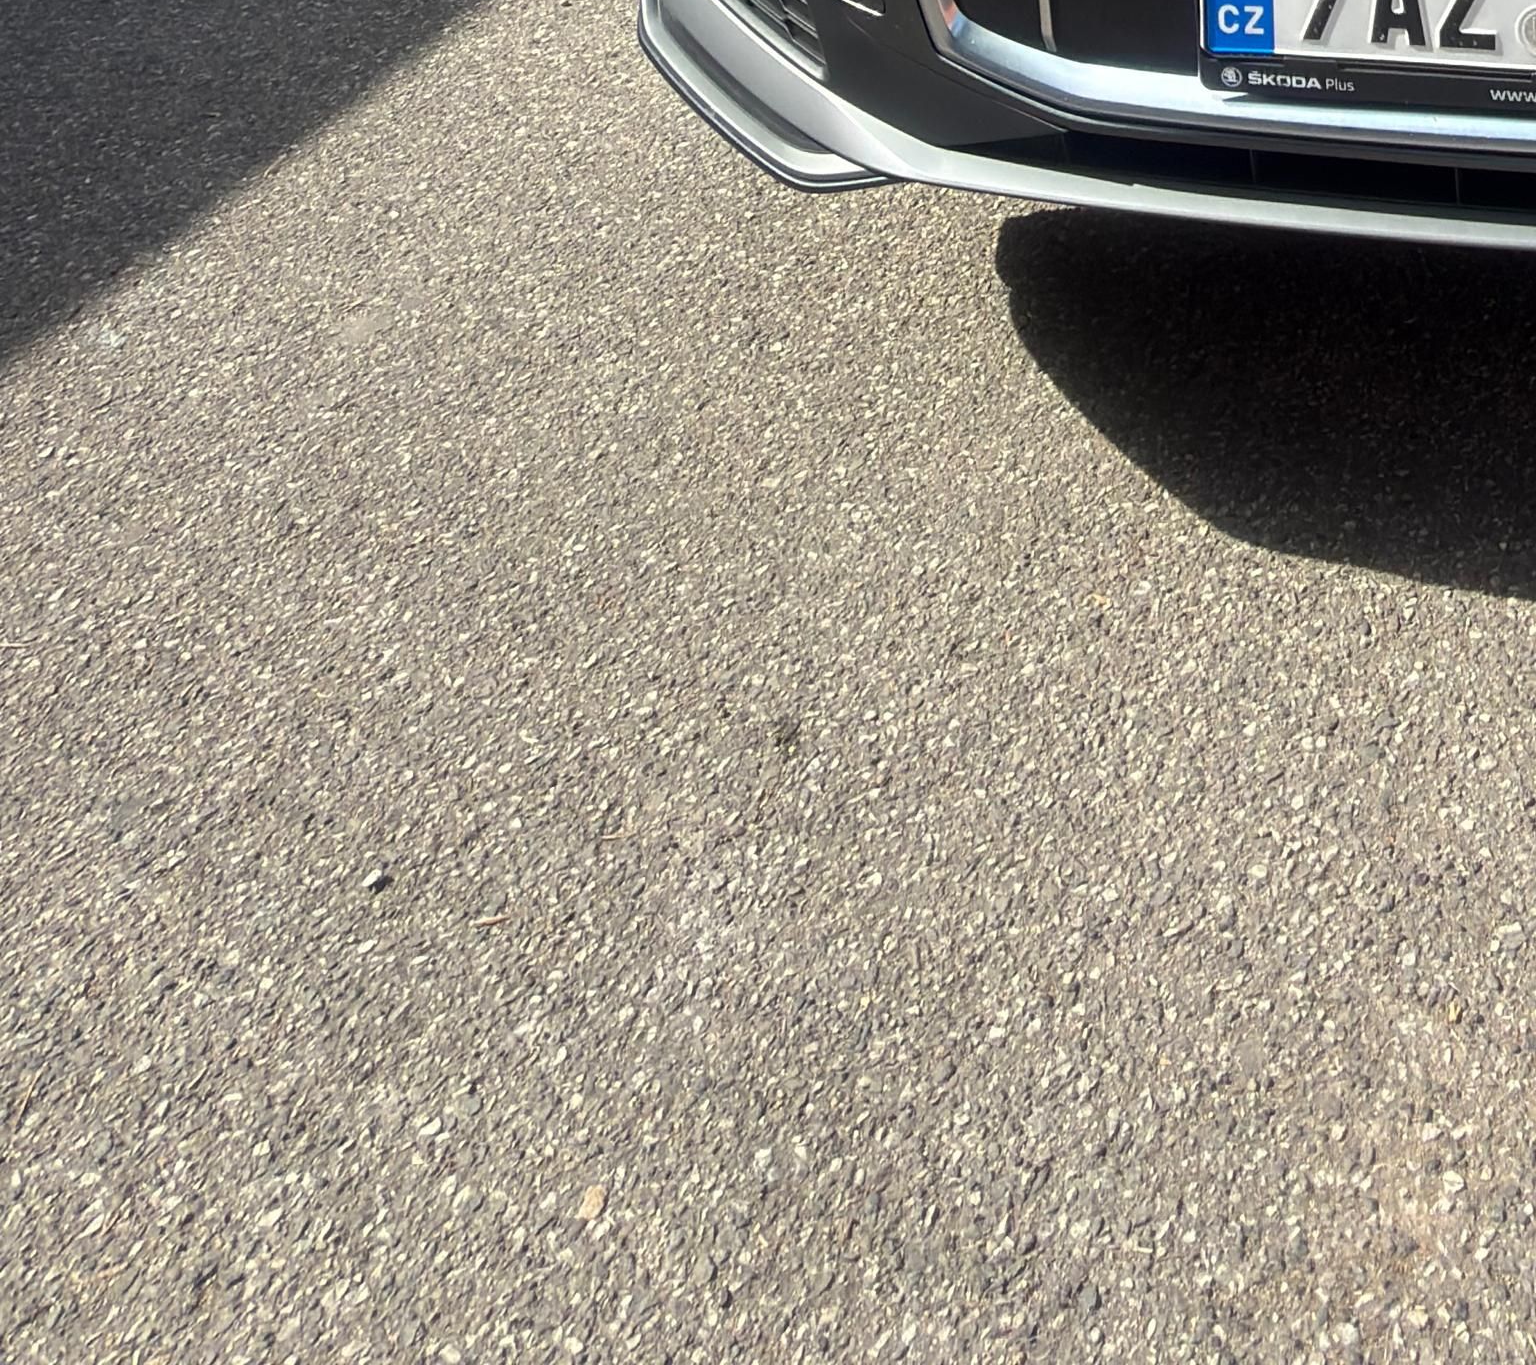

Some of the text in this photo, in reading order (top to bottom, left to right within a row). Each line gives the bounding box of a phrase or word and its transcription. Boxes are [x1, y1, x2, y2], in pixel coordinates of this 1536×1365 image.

[1217, 4, 1265, 35] CZ
[1247, 69, 1355, 93] ŠKODA Plus
